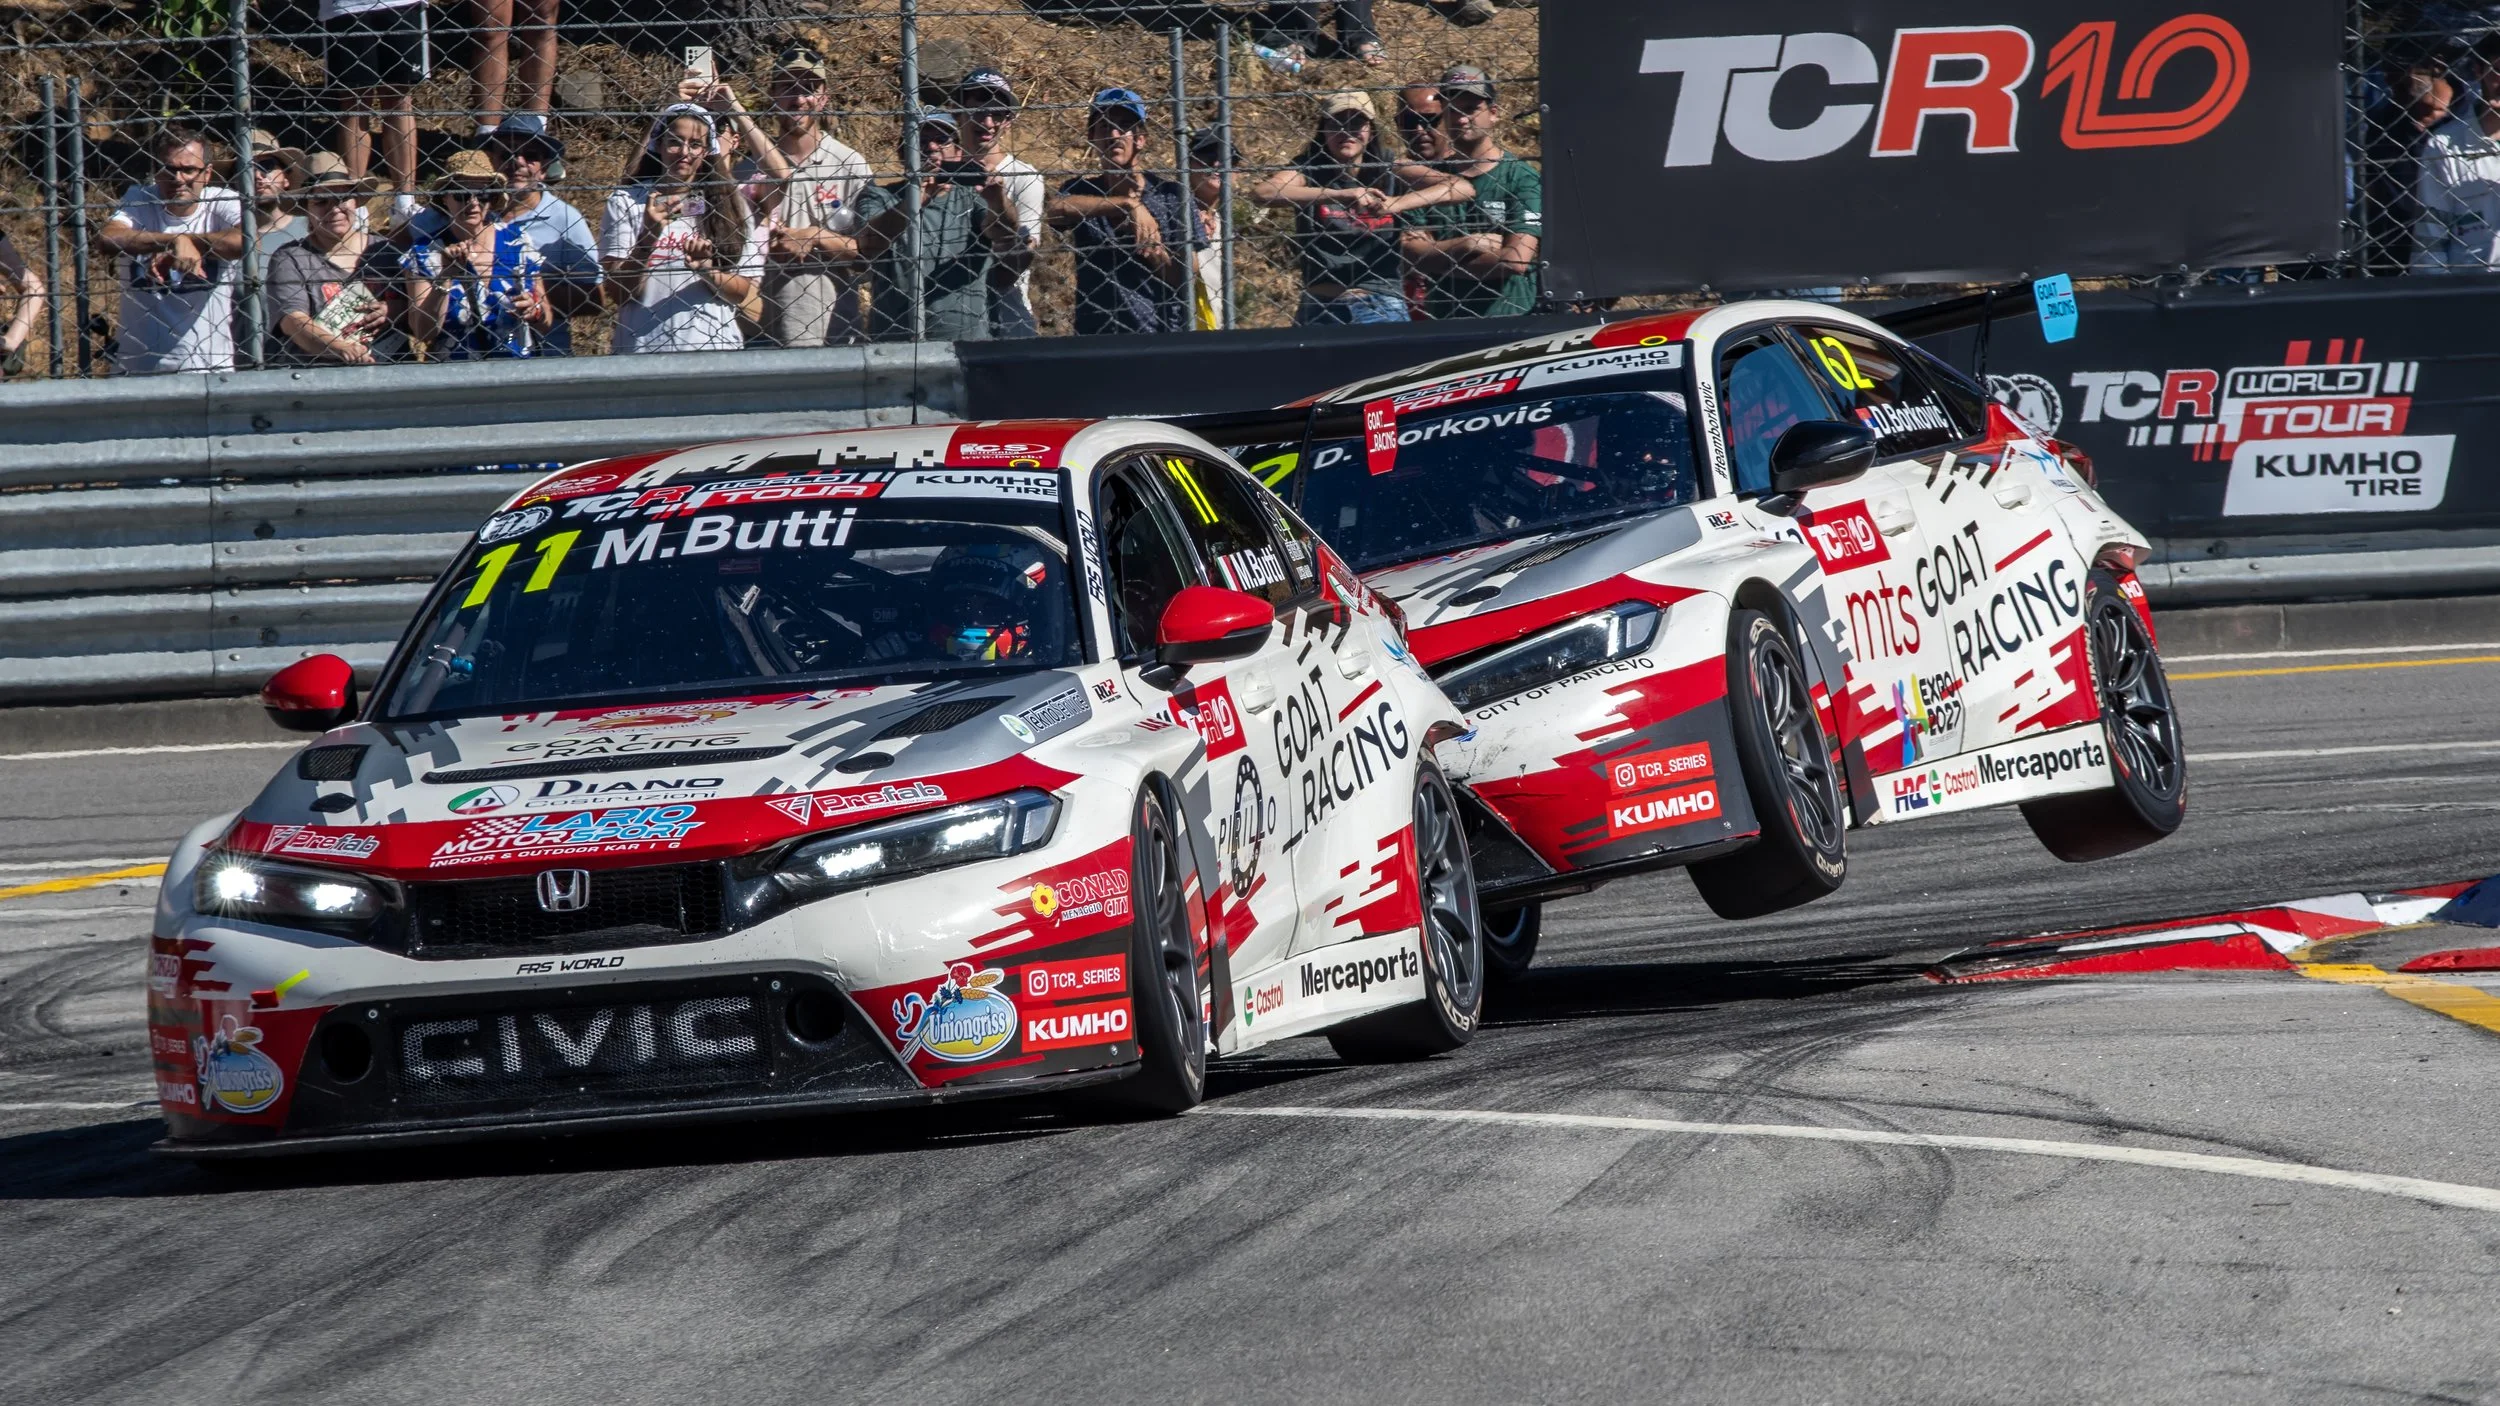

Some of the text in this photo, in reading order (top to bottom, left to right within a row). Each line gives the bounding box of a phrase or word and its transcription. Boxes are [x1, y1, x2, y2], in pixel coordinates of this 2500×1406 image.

[2037, 282, 2057, 301] GOAT
[2049, 298, 2076, 319] RACING
[1546, 350, 1670, 374] KUMHO
[1615, 357, 1670, 371] TIRE
[1810, 336, 1874, 391] 62
[1394, 382, 1506, 412] TOUR
[1395, 375, 1485, 402] ORLD
[2070, 369, 2220, 423] TCR
[2235, 368, 2364, 394] WORLD
[1366, 411, 1383, 430] GOAT
[1398, 402, 1552, 446] orković
[1698, 382, 1728, 479] #teamborkovic
[2253, 402, 2395, 437] TOUR
[1374, 431, 1397, 452] RACING
[1249, 452, 1300, 500] 2
[2255, 450, 2422, 479] KUMHO
[710, 475, 841, 490] WORLD
[721, 485, 868, 503] TOUR
[916, 475, 1058, 488] KUMHO
[995, 485, 1058, 497] TIRE
[1166, 459, 1220, 524] 11
[2344, 478, 2422, 497] TIRE
[562, 485, 694, 519] TCR
[1705, 511, 1733, 528] RC2
[592, 507, 857, 569] M.Butti
[1077, 509, 1100, 568] WORLD
[1808, 515, 1877, 562] TCR10
[461, 530, 581, 609] 11
[1230, 546, 1286, 591] M.Butti
[1916, 520, 1989, 617] GOAT
[1845, 569, 1921, 664] mts
[1954, 559, 2081, 683] RACING
[1092, 678, 1118, 702] RC2
[1475, 657, 1656, 722] CITY OF PANCEVO
[1919, 671, 1956, 706] EXPO
[1273, 665, 1333, 779] GOAT
[1927, 700, 1961, 736] 2027
[507, 733, 652, 752] GOAT
[543, 737, 743, 759] RACING
[1637, 753, 1707, 777] TCR_SERIES
[1944, 766, 1980, 796] Castrol
[1977, 738, 2107, 785] Mercaporta
[524, 791, 717, 808] Costruzioni
[535, 776, 725, 798] DIANO
[813, 781, 946, 813] Prefab
[521, 804, 698, 834] LARIO
[1613, 790, 1715, 828] KUMHO
[288, 830, 381, 853] Prefab
[1218, 796, 1277, 859] PIRILLO
[429, 856, 496, 868] INDOOR
[500, 852, 512, 860] &
[517, 846, 600, 859] OUTDOOR
[1057, 868, 1129, 907] CONAD
[1062, 895, 1129, 921] MENAGGIO CITY
[517, 956, 625, 976] FRS WORLD
[1051, 966, 1121, 989] TCR_SERIES
[1256, 946, 1418, 1017] Castrol Mercaporta
[402, 995, 758, 1078] CIVIC
[929, 1005, 1008, 1045] Uniongriss
[1028, 1009, 1128, 1041] KUMHO
